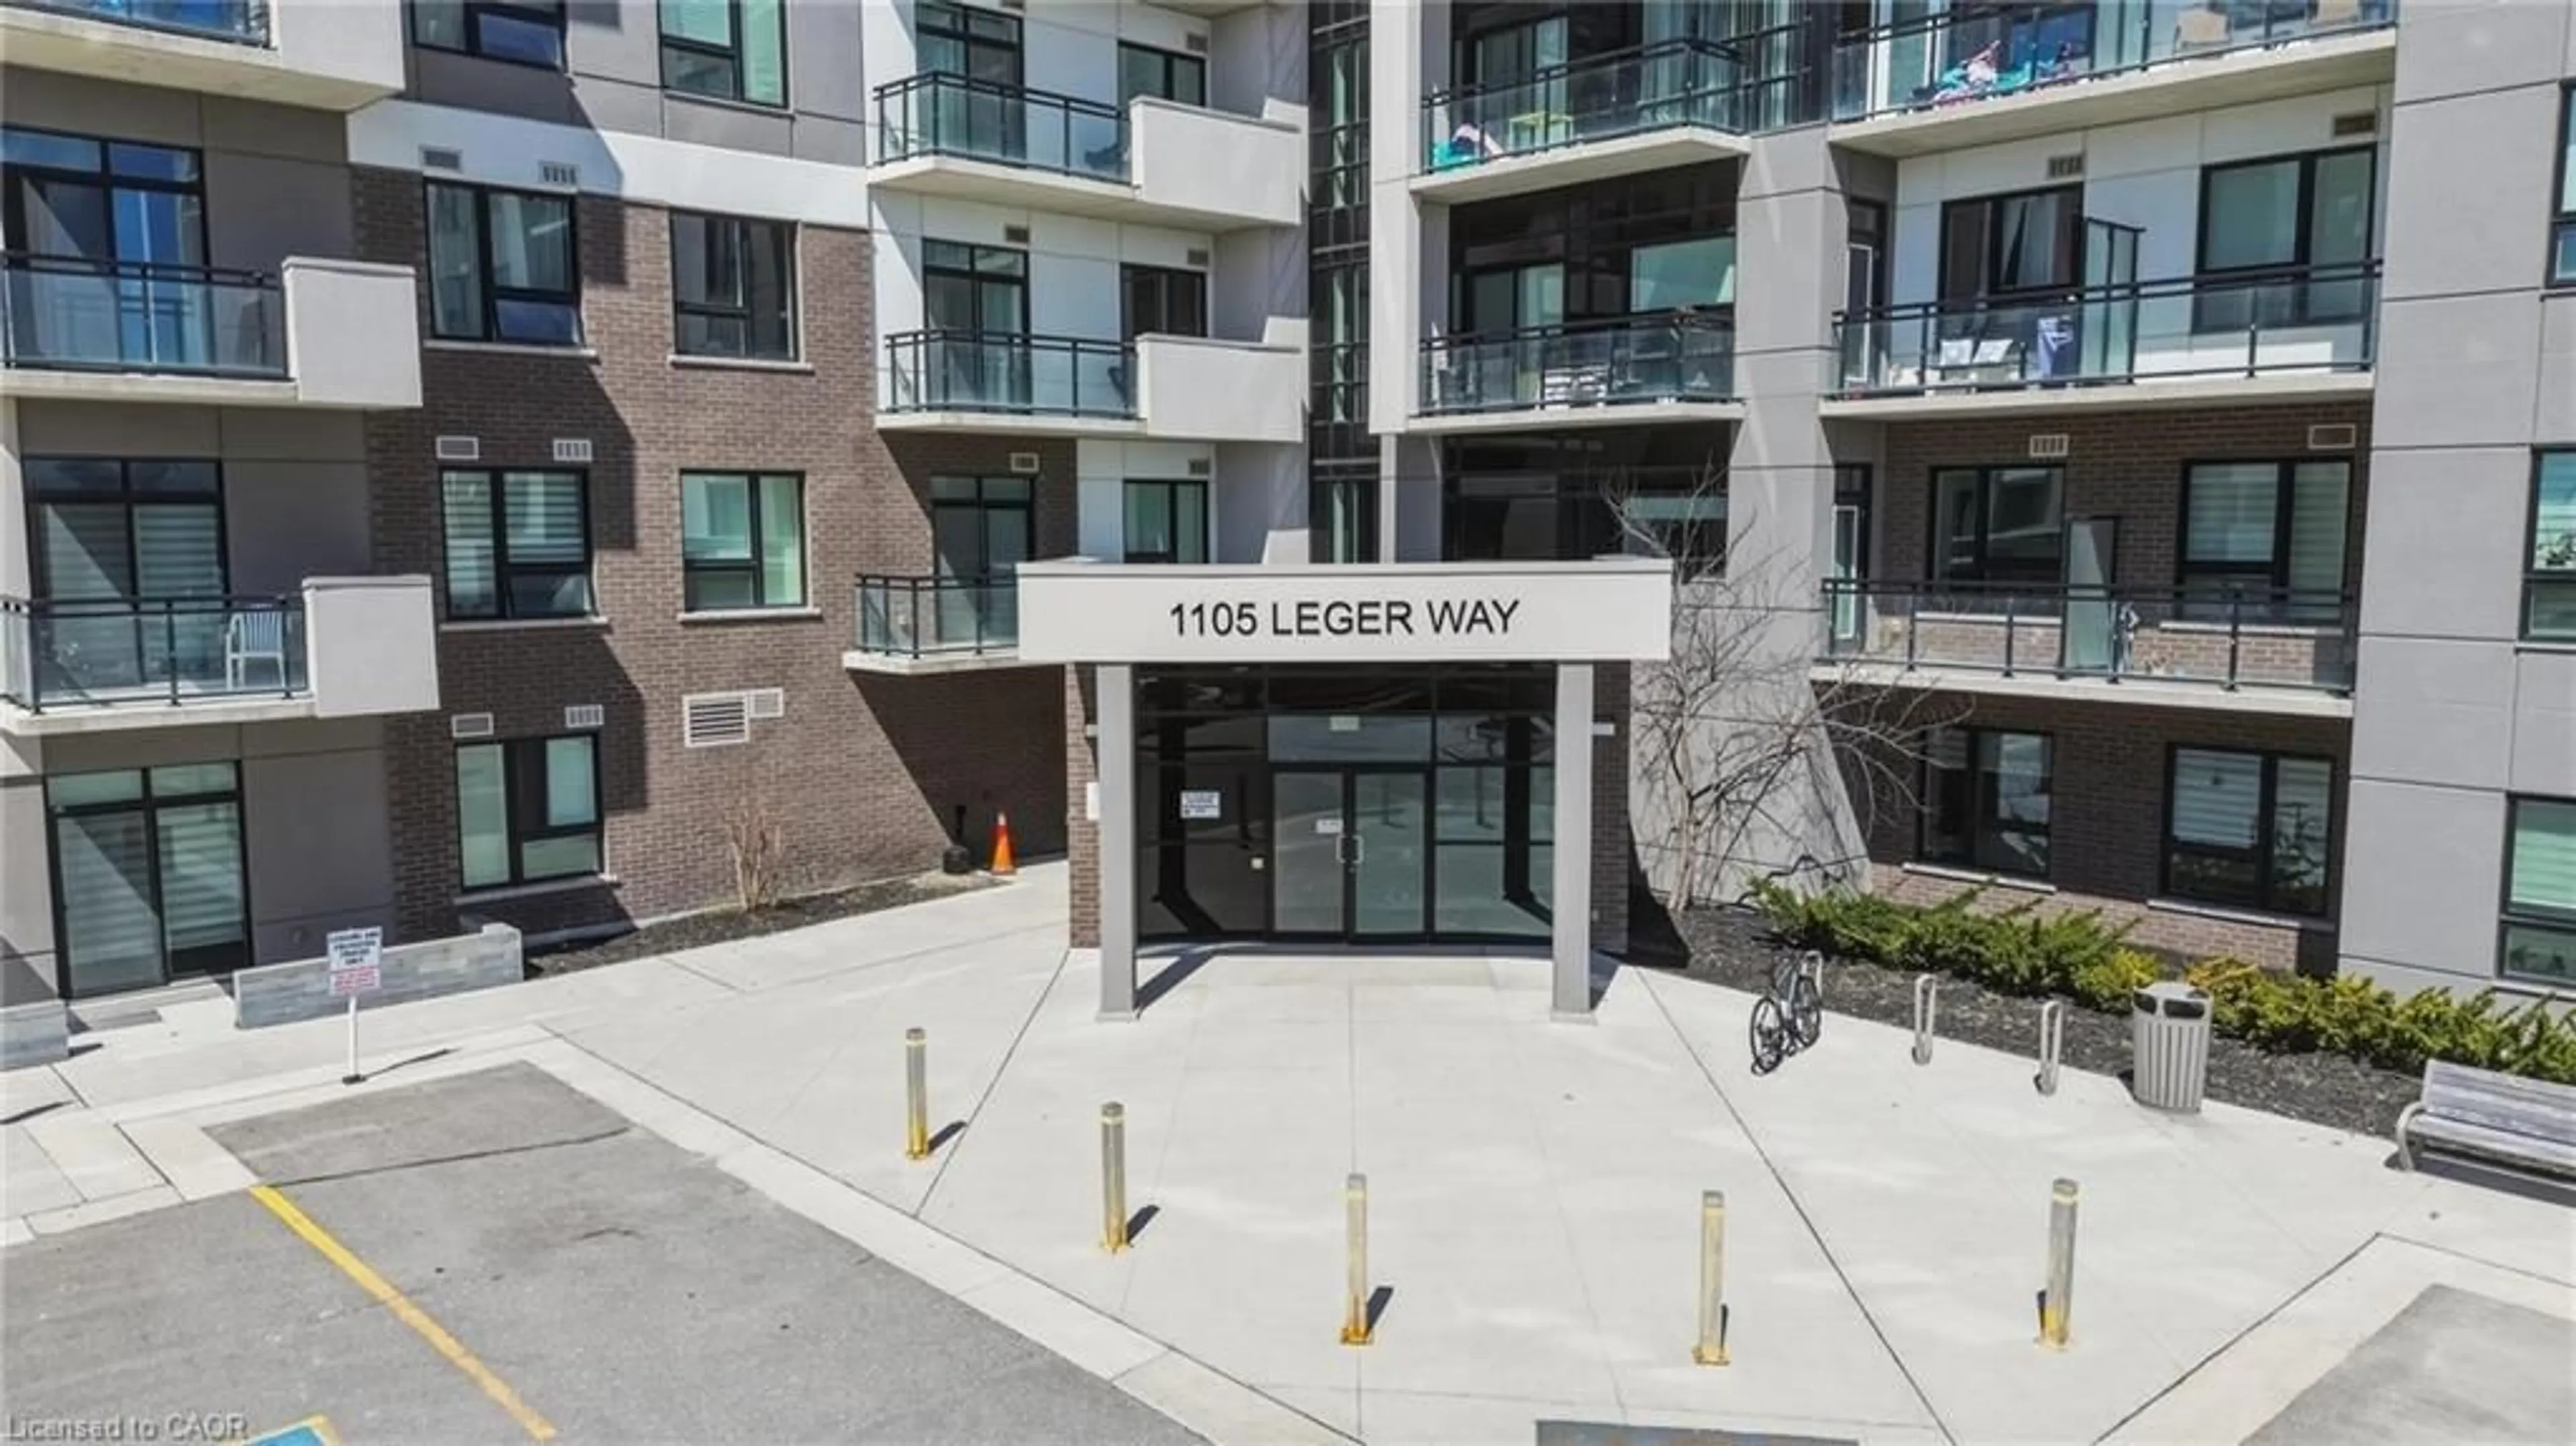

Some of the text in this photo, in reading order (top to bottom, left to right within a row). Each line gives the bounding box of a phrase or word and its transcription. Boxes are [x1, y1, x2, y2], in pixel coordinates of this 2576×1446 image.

[1169, 599, 1520, 636] 1105 LEGER WAY
